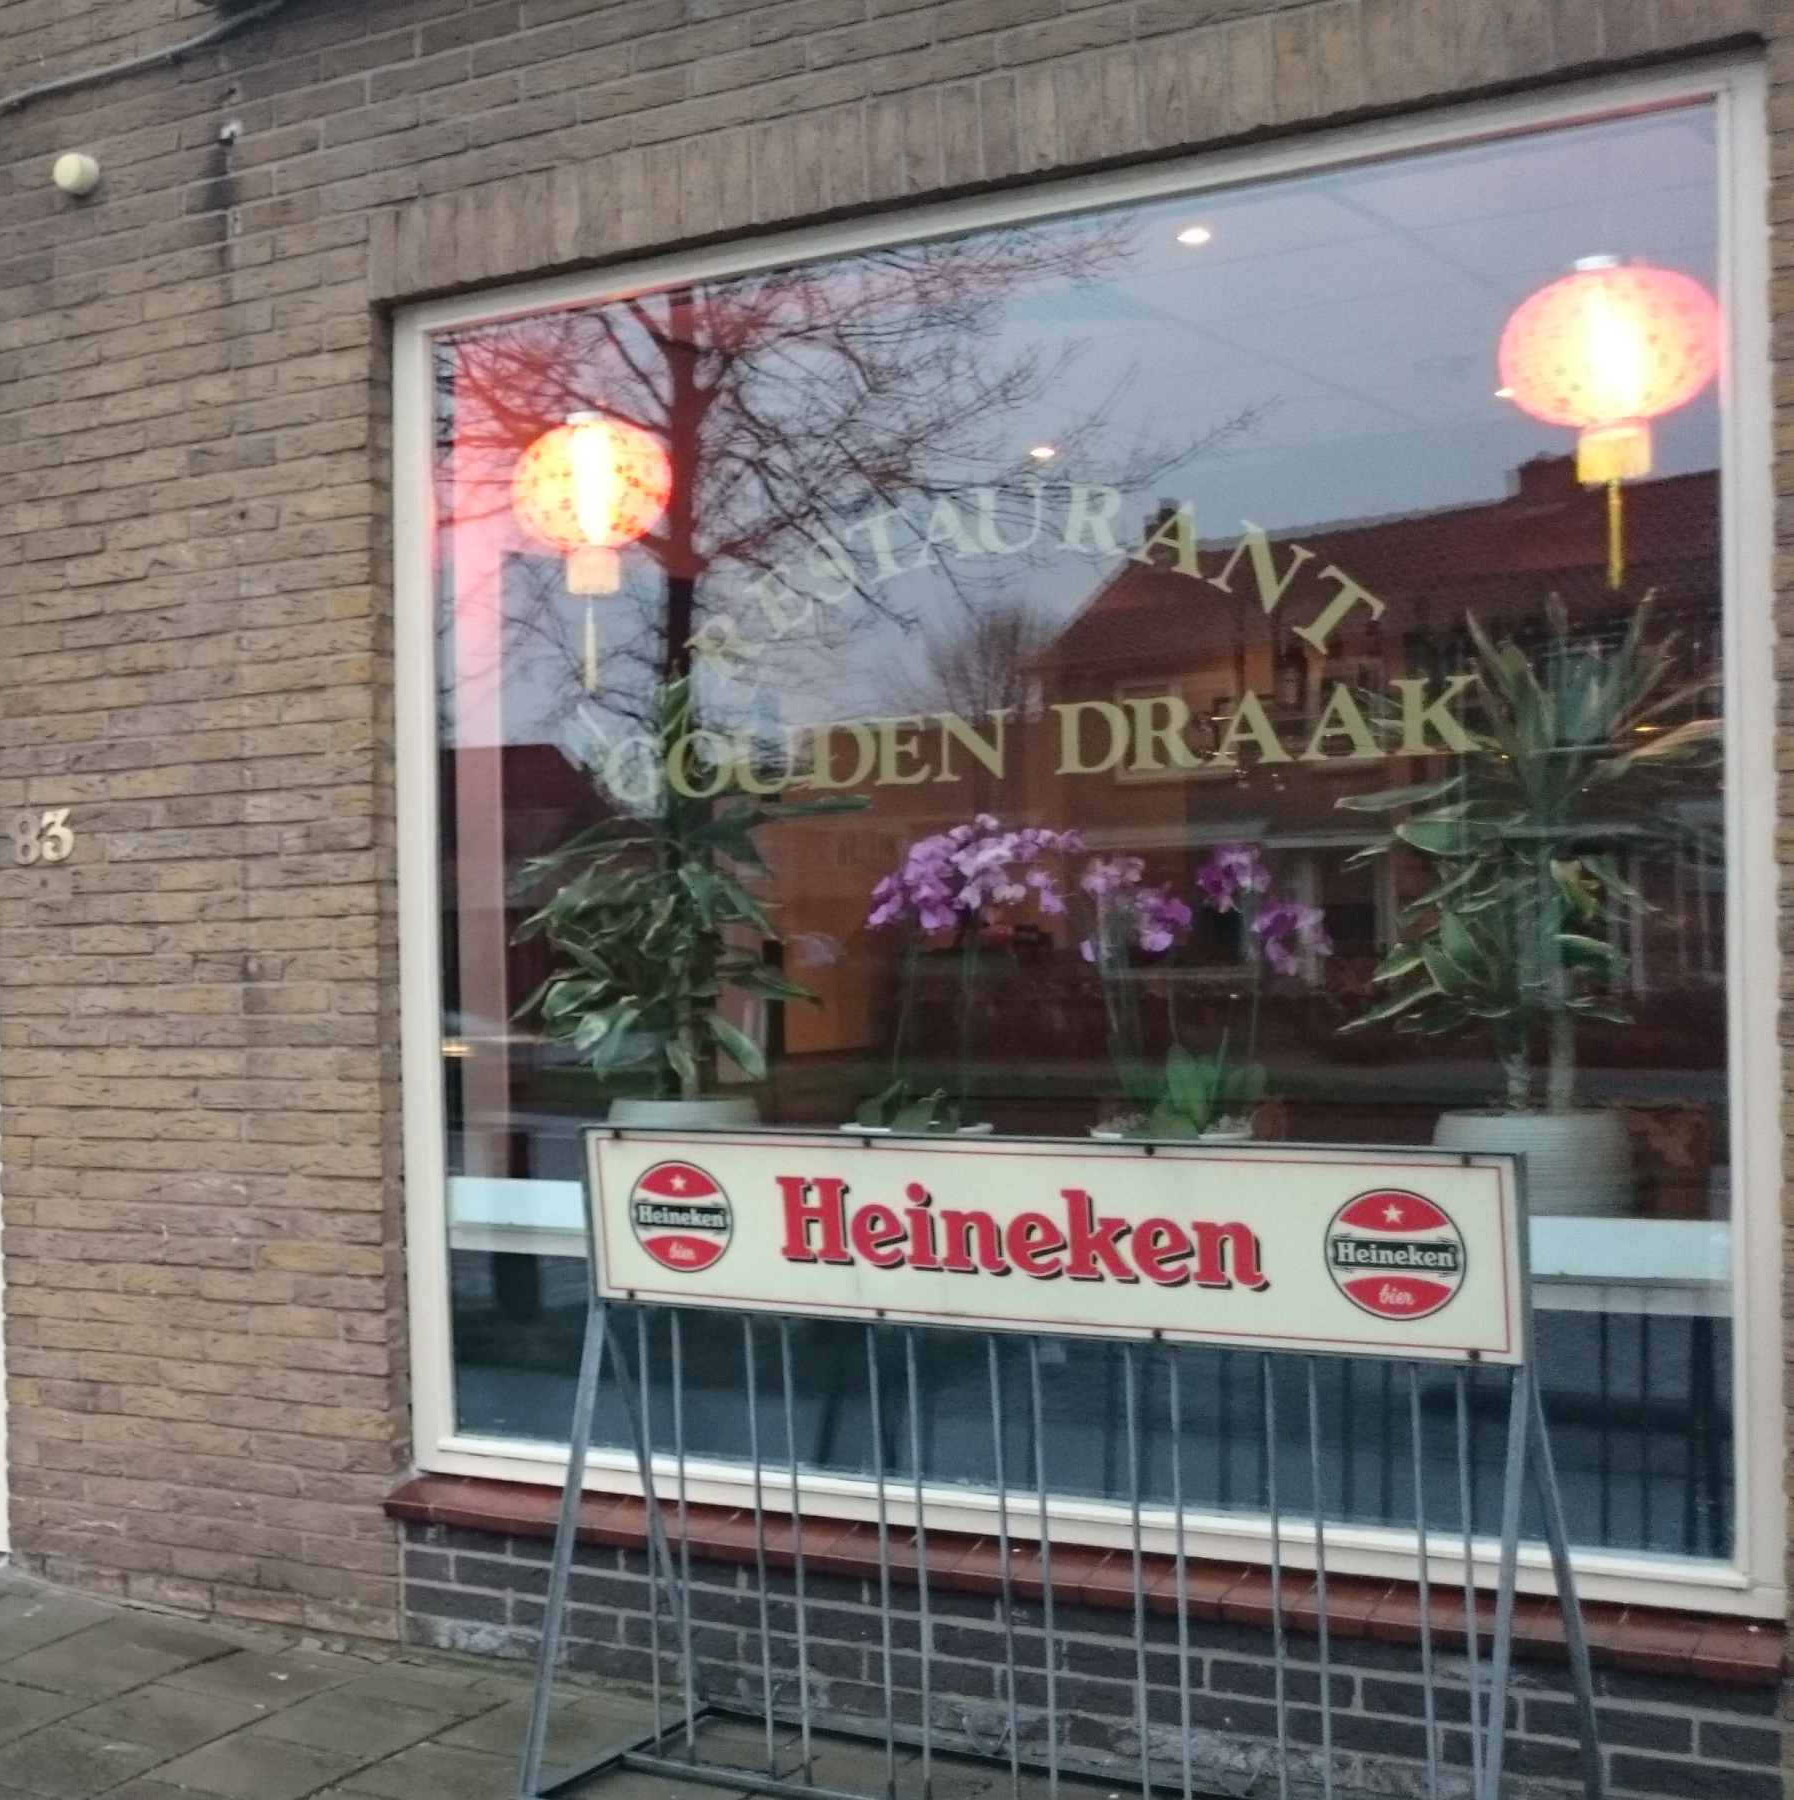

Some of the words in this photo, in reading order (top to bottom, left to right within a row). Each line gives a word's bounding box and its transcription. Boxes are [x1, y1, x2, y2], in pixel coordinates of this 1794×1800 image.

[683, 482, 1386, 680] RESTAURANT
[605, 707, 1011, 801] GOUDEN
[1049, 673, 1483, 776] DRAAK
[7, 808, 74, 865] 83
[637, 1204, 725, 1229] Heineken
[775, 1175, 1270, 1292] Heineken
[667, 1240, 698, 1262] bier
[1336, 1241, 1455, 1267] Heineken
[1378, 1282, 1416, 1307] bier
